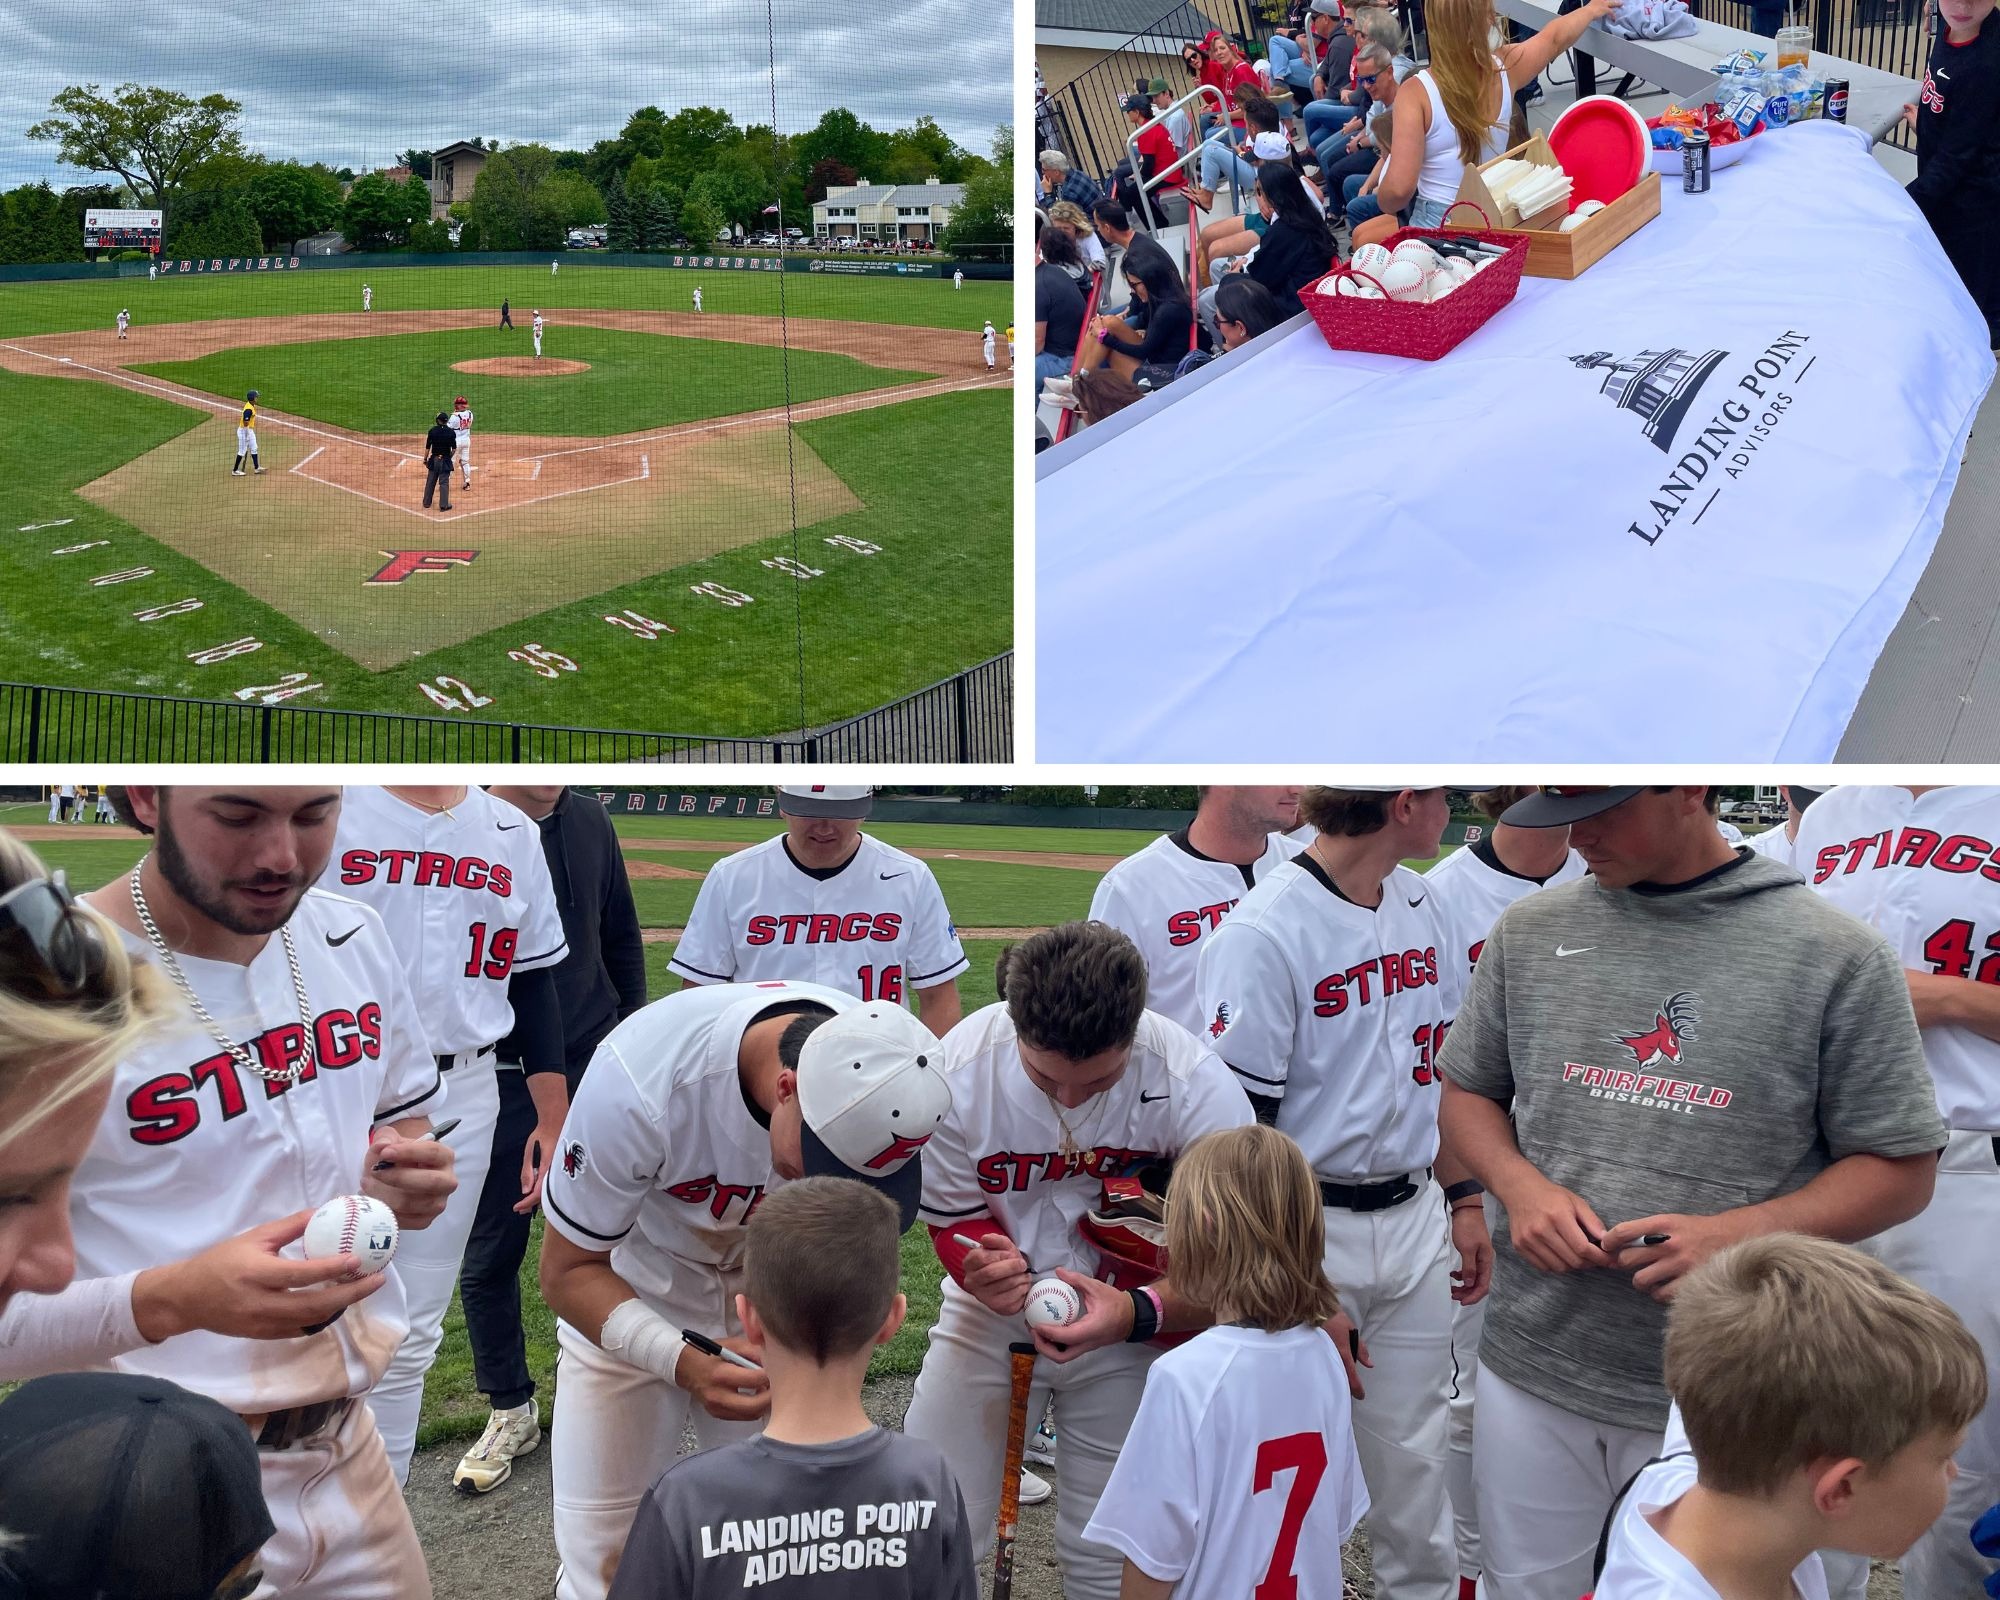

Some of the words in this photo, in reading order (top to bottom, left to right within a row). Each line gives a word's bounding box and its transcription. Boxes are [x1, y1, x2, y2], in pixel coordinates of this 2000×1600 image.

[160, 257, 300, 273] FAIRFIELD
[1627, 399, 1751, 547] LANDING
[1738, 330, 1811, 400] POINT
[1724, 391, 1793, 480] ADVISORS
[362, 550, 481, 587] F
[604, 609, 676, 641] 34
[186, 636, 263, 666] 18
[507, 642, 579, 680] 35
[418, 675, 496, 712] 42
[598, 792, 775, 815] FAIRFIE
[340, 849, 513, 898] STAGS
[746, 912, 902, 945] STAGS
[464, 921, 520, 981] 19
[857, 963, 902, 1005] 16
[1313, 945, 1439, 1018] STAGS
[126, 1001, 382, 1146] STAGS
[1562, 1062, 1733, 1109] FAIRFIELD
[1589, 1088, 1695, 1115] BASEBALL
[863, 1131, 934, 1170] F
[701, 1507, 844, 1560] LANDING
[855, 1499, 937, 1537] POINT
[1253, 1431, 1328, 1600] 7
[742, 1537, 907, 1589] ADVISORS
